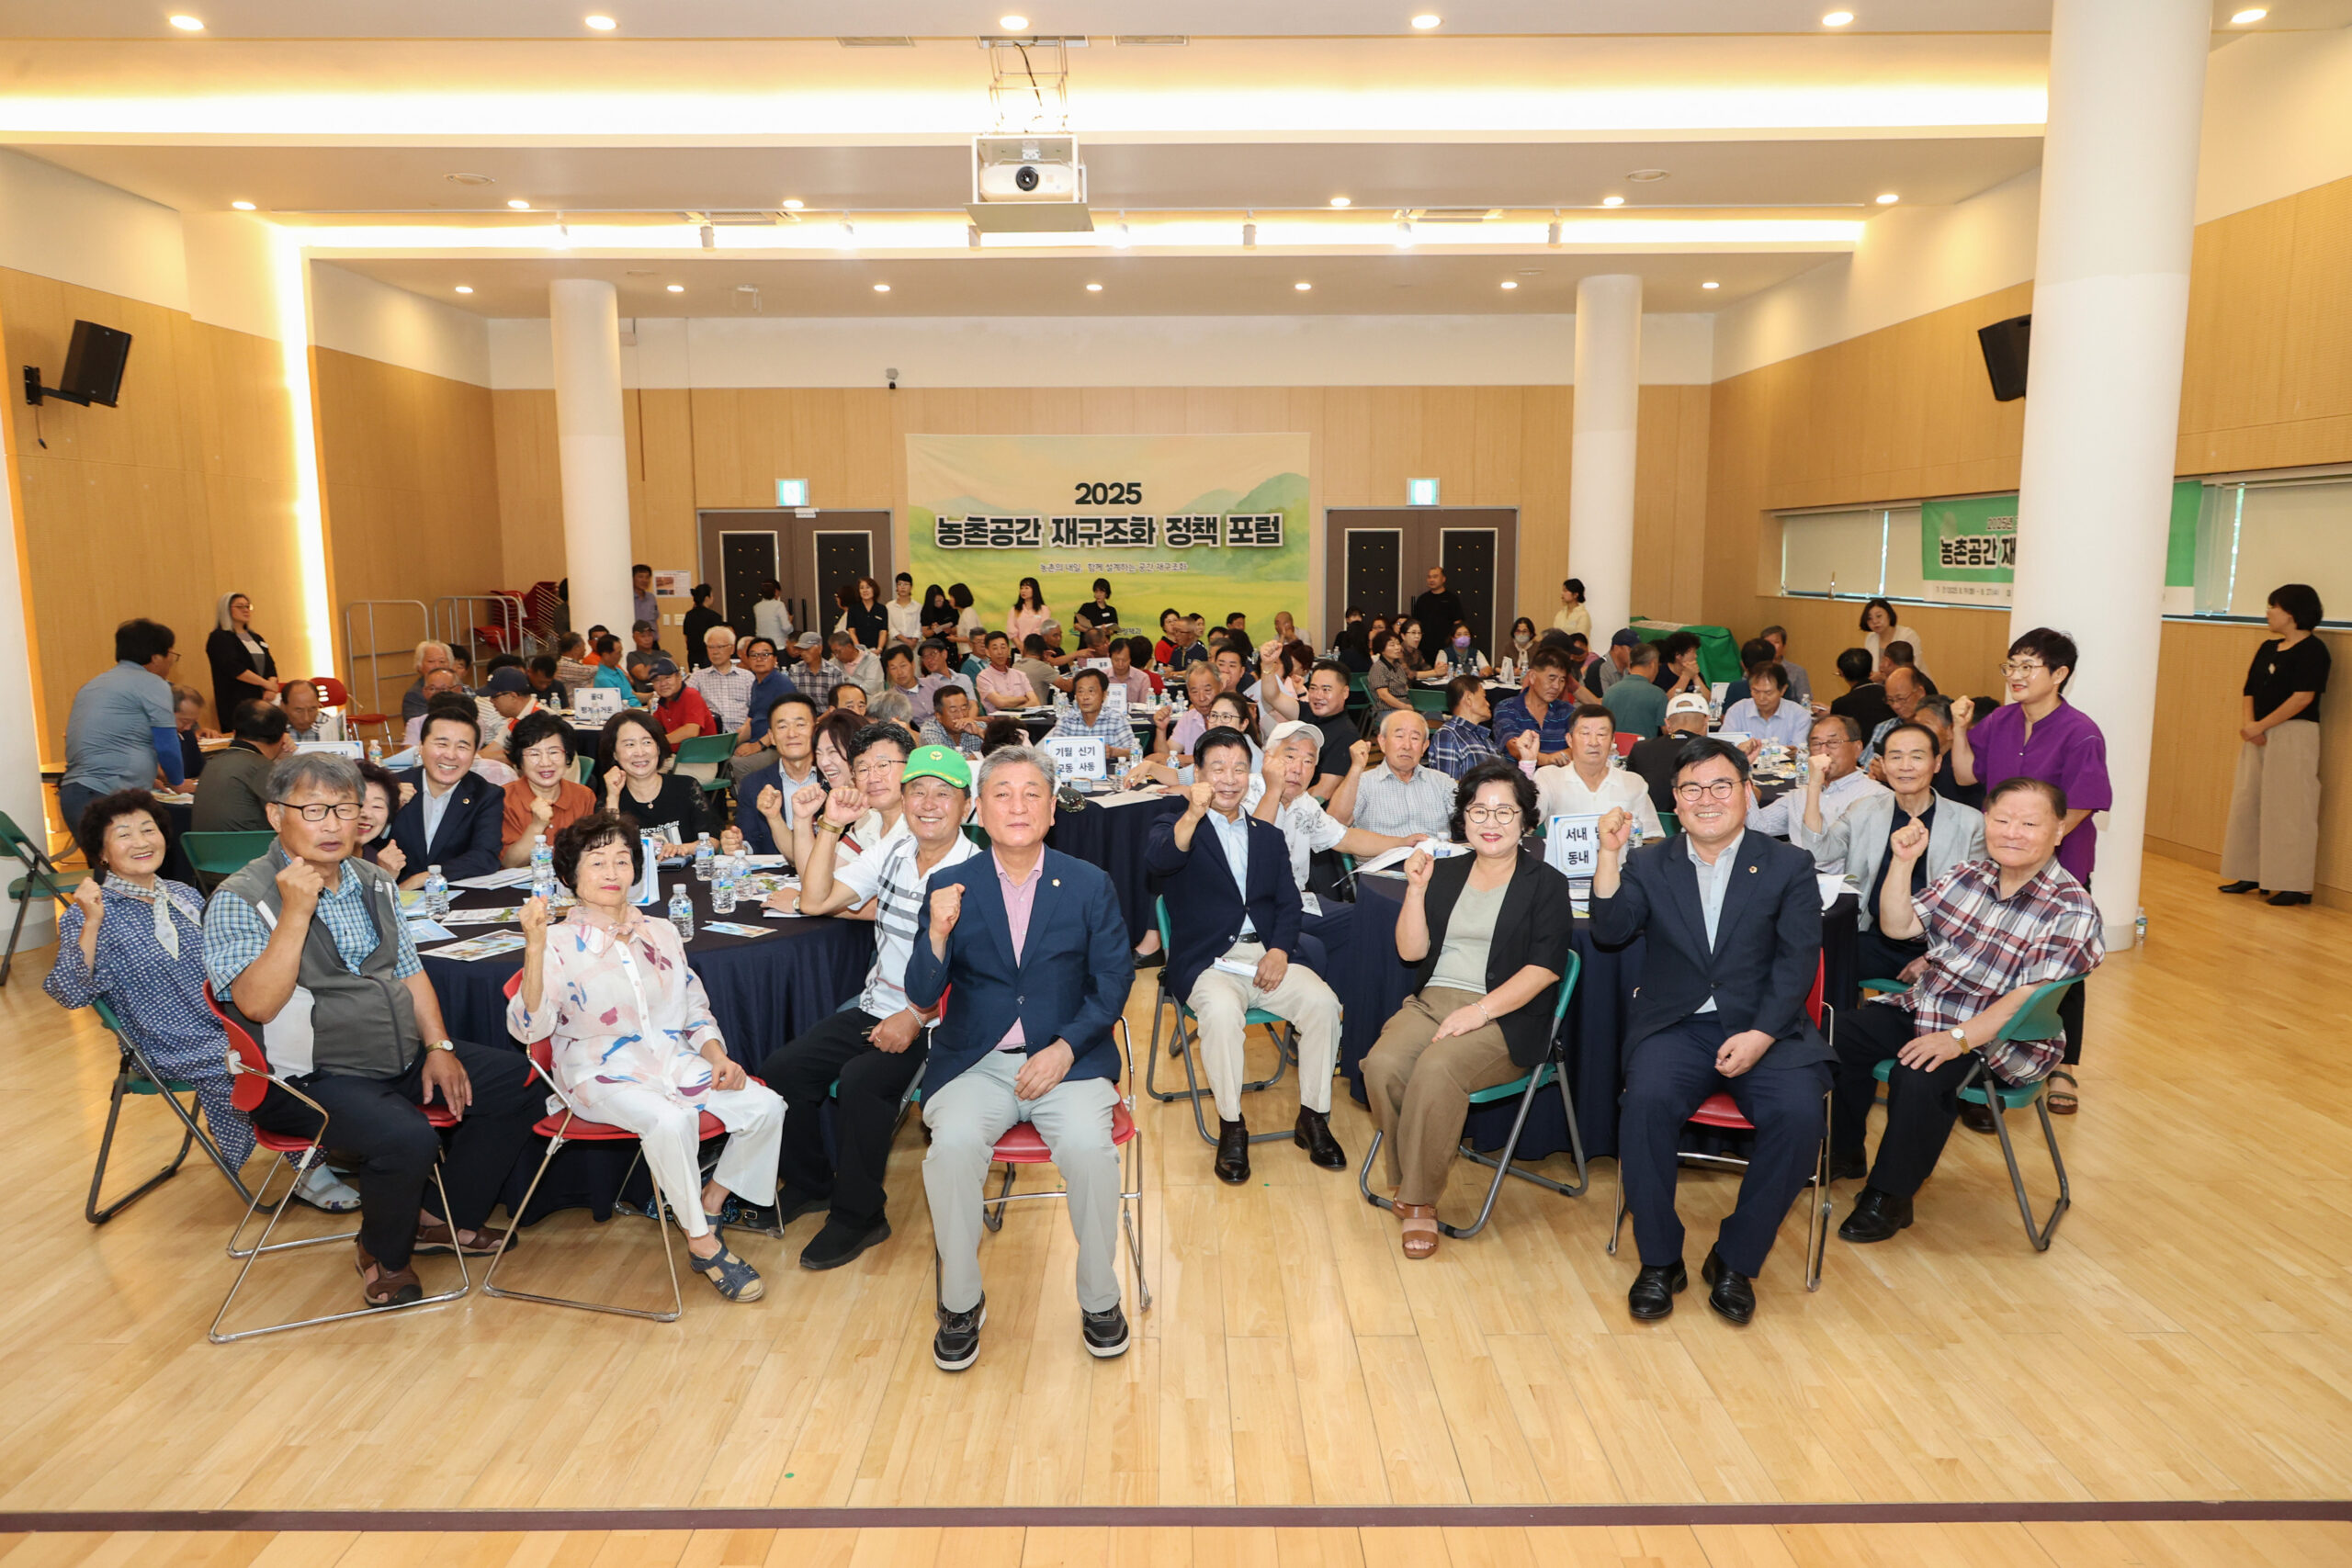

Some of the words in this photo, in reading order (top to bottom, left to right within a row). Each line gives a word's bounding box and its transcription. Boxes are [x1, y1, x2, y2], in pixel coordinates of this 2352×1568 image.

[1074, 482, 1142, 505] 2025
[936, 515, 1042, 547] 농촌공간
[1050, 515, 1156, 547] 재구조화
[1164, 514, 1220, 547] 정책
[1227, 513, 1282, 545] 포럼
[1939, 537, 1998, 567] 농촌공간
[1040, 563, 1064, 573] 농촌의
[1157, 562, 1188, 572] 재구조화
[1056, 747, 1072, 757] 기월
[1079, 746, 1095, 756] 신기
[1079, 761, 1095, 772] 사동
[1566, 827, 1588, 841] 서내
[1567, 851, 1589, 865] 동내
